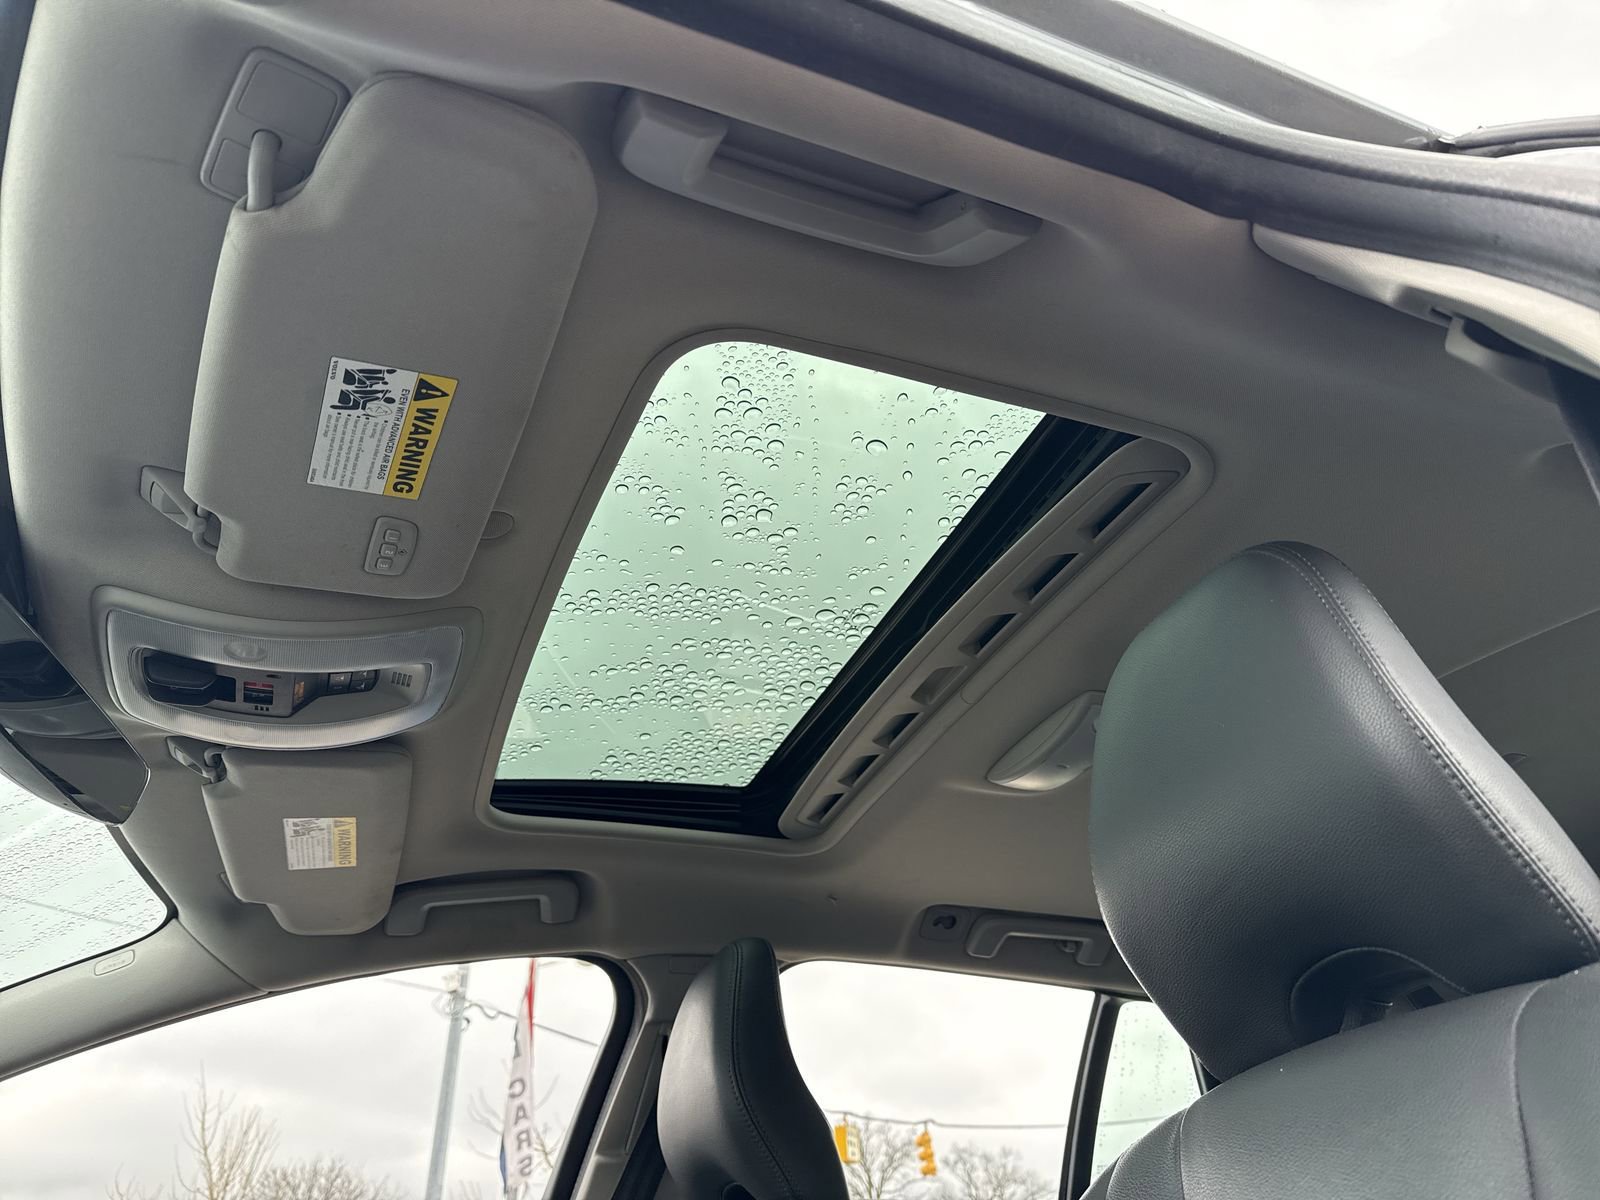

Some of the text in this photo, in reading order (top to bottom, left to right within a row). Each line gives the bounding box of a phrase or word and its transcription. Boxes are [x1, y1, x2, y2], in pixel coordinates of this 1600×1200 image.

[376, 388, 410, 480] EVEN WITH ADVANCED AIR BAGS
[392, 408, 439, 494] WARNING
[337, 828, 352, 865] WARNING
